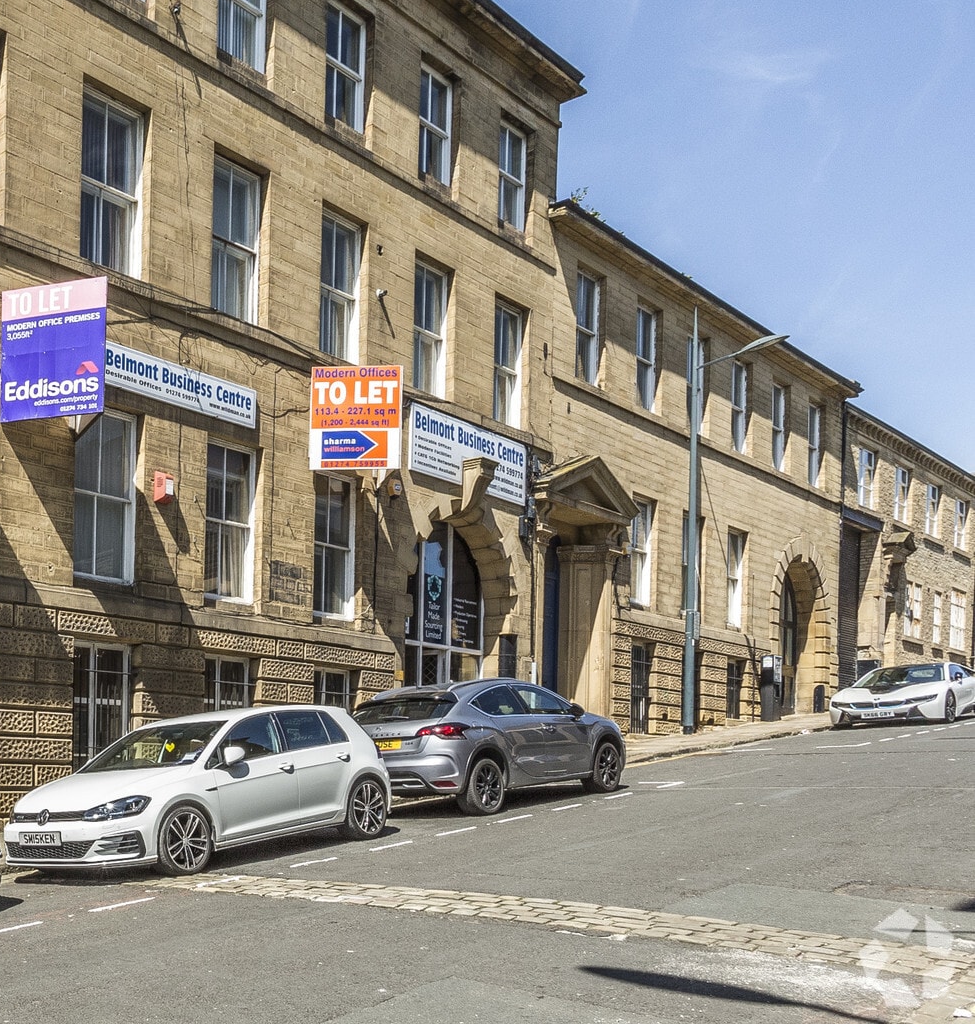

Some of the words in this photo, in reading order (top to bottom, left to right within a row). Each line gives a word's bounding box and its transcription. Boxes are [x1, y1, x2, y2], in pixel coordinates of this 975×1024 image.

[8, 292, 32, 317] TO
[39, 285, 73, 313] LET
[6, 321, 37, 332] MODERN
[38, 316, 63, 327] OFFICE
[64, 312, 101, 323] PREMISES
[315, 369, 356, 378] Modern
[359, 367, 397, 377] Offices
[105, 349, 159, 381] Belmont
[162, 366, 212, 398] Business
[216, 385, 252, 411] Centre
[105, 369, 137, 384] Desirable
[138, 379, 162, 392] Offices
[165, 388, 181, 398] 01274
[4, 376, 99, 402] Eddisons
[314, 380, 347, 405] TO
[354, 380, 398, 404] LET
[34, 393, 98, 407] eddisons.com/property
[209, 402, 251, 420] www.wildman.co.uk
[315, 407, 339, 416] 113.4
[347, 407, 371, 415] 227.1
[374, 408, 385, 416] sq
[415, 410, 455, 441] Belmont
[458, 426, 495, 456] Business
[497, 442, 524, 467] Centre
[323, 445, 365, 453] williamson
[496, 463, 505, 473] 274
[428, 601, 440, 610] Tailor
[428, 611, 440, 620] Made
[425, 619, 443, 632] Sourcing
[426, 629, 441, 639] Limited
